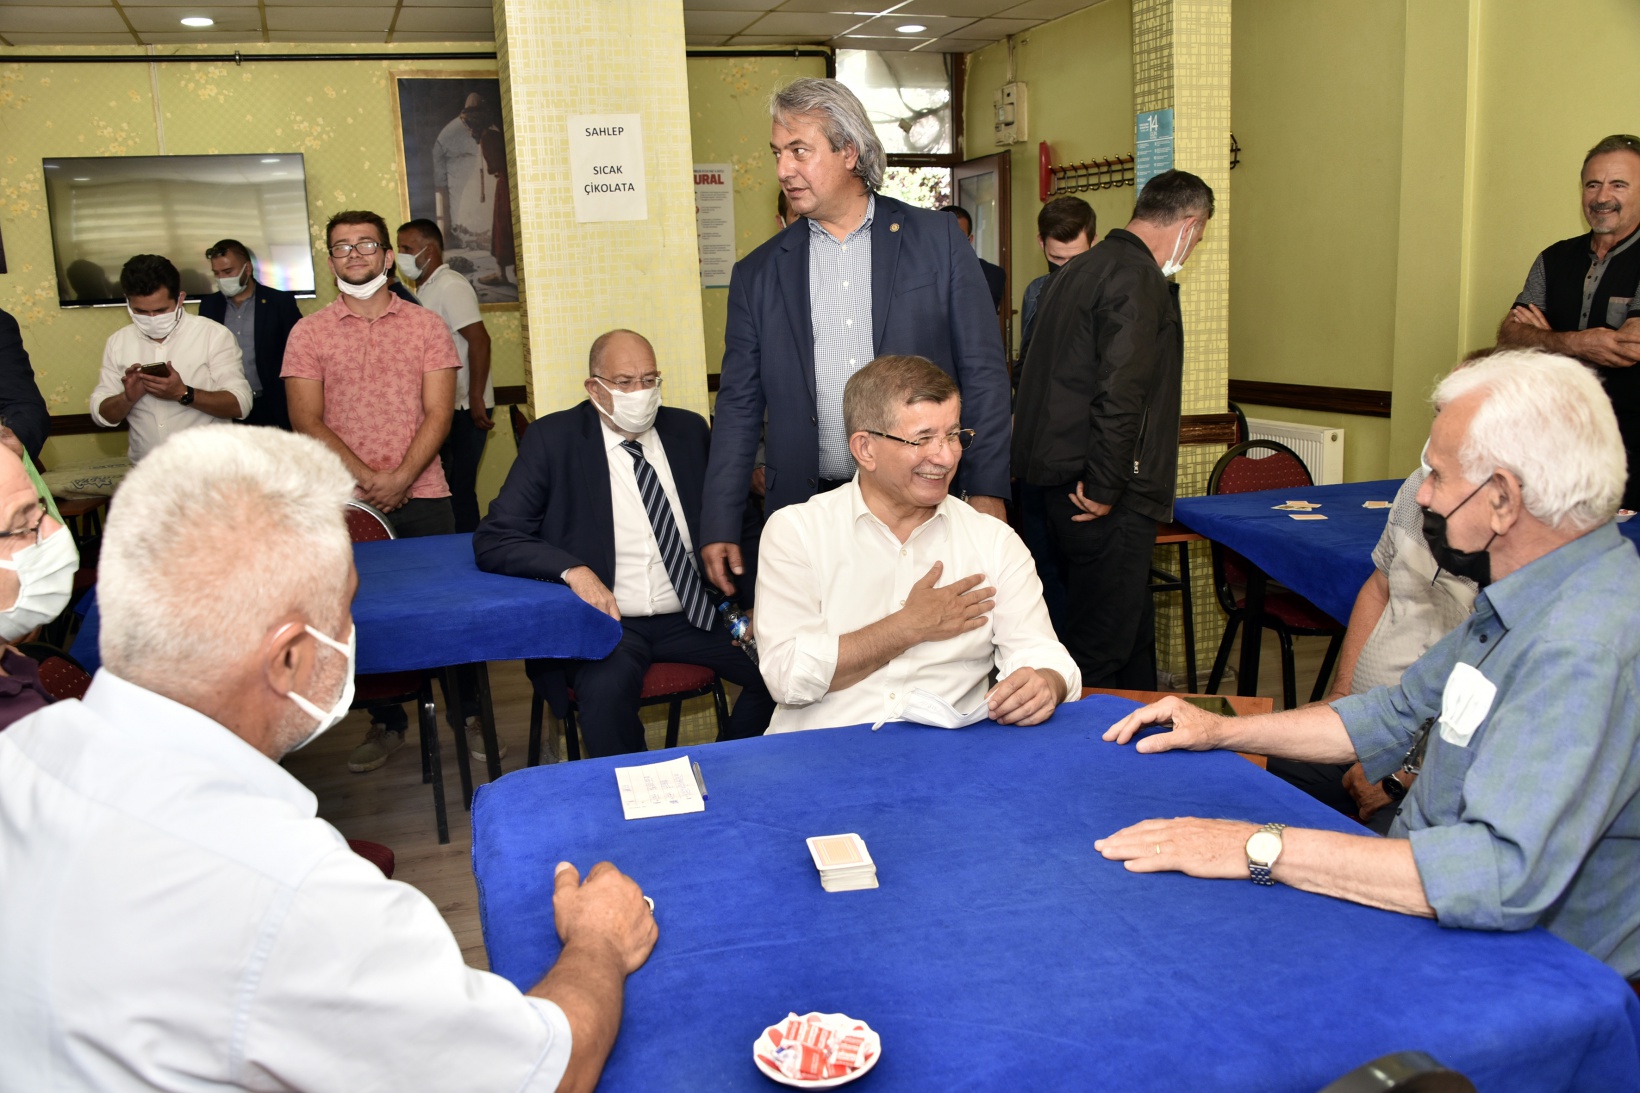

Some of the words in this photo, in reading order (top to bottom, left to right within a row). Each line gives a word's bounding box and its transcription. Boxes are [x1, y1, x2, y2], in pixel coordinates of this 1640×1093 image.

[1147, 114, 1158, 131] 14
[585, 127, 624, 137] SAHLEP
[593, 165, 623, 175] SICAK
[694, 173, 724, 185] URAL
[584, 182, 635, 195] ÇİKOLATA
